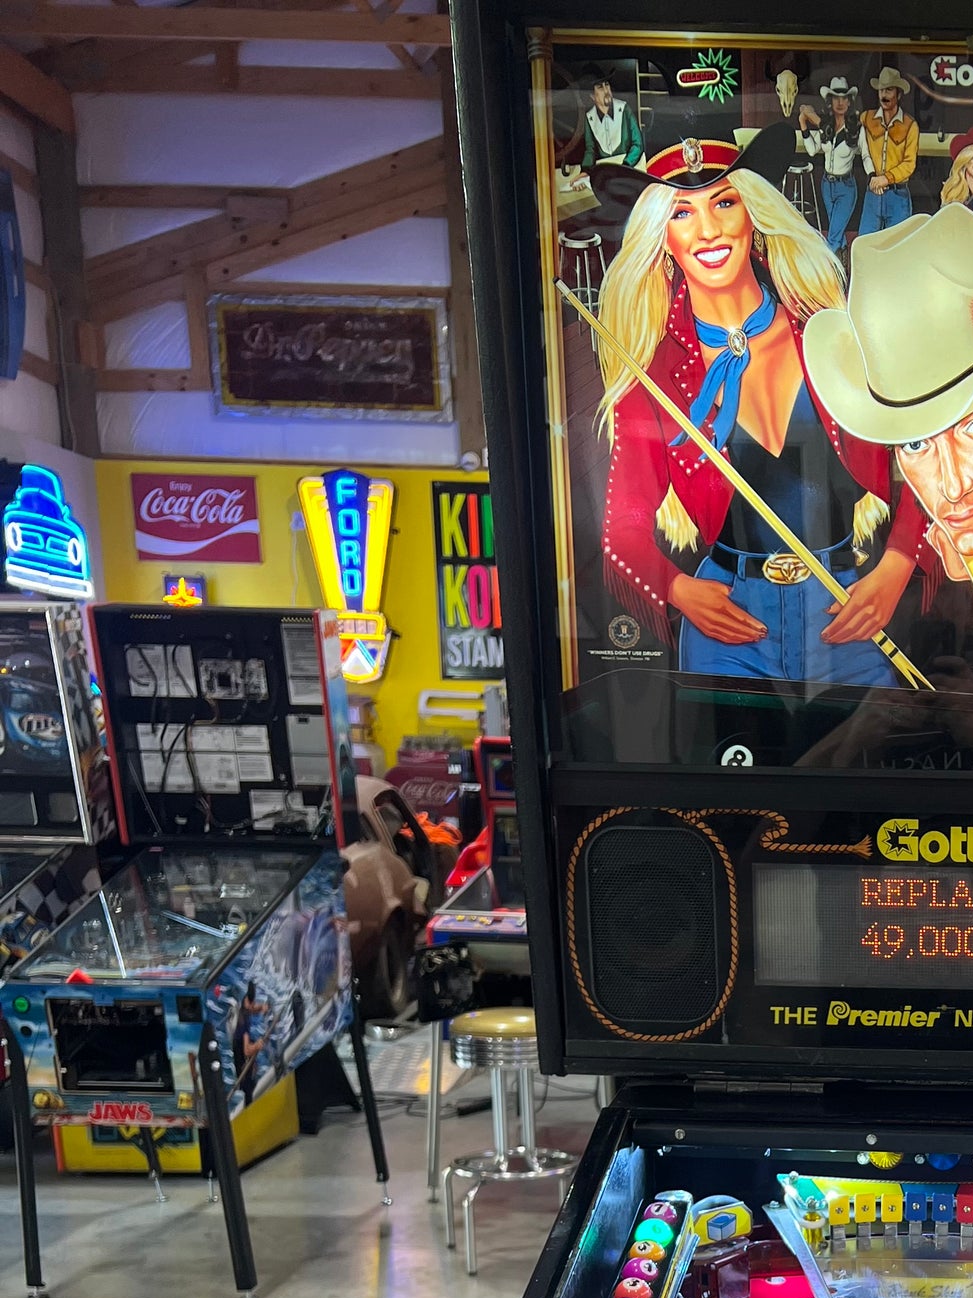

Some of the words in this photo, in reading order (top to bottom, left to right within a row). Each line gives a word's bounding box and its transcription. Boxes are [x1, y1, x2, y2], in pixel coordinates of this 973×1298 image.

[140, 488, 247, 524] Coca-Cola
[336, 477, 362, 597] FORD
[770, 1006, 817, 1025] THE
[827, 1001, 941, 1027] Premier
[89, 1102, 153, 1122] JAWS
[654, 1204, 663, 1213] 7
[638, 1241, 649, 1251] 5
